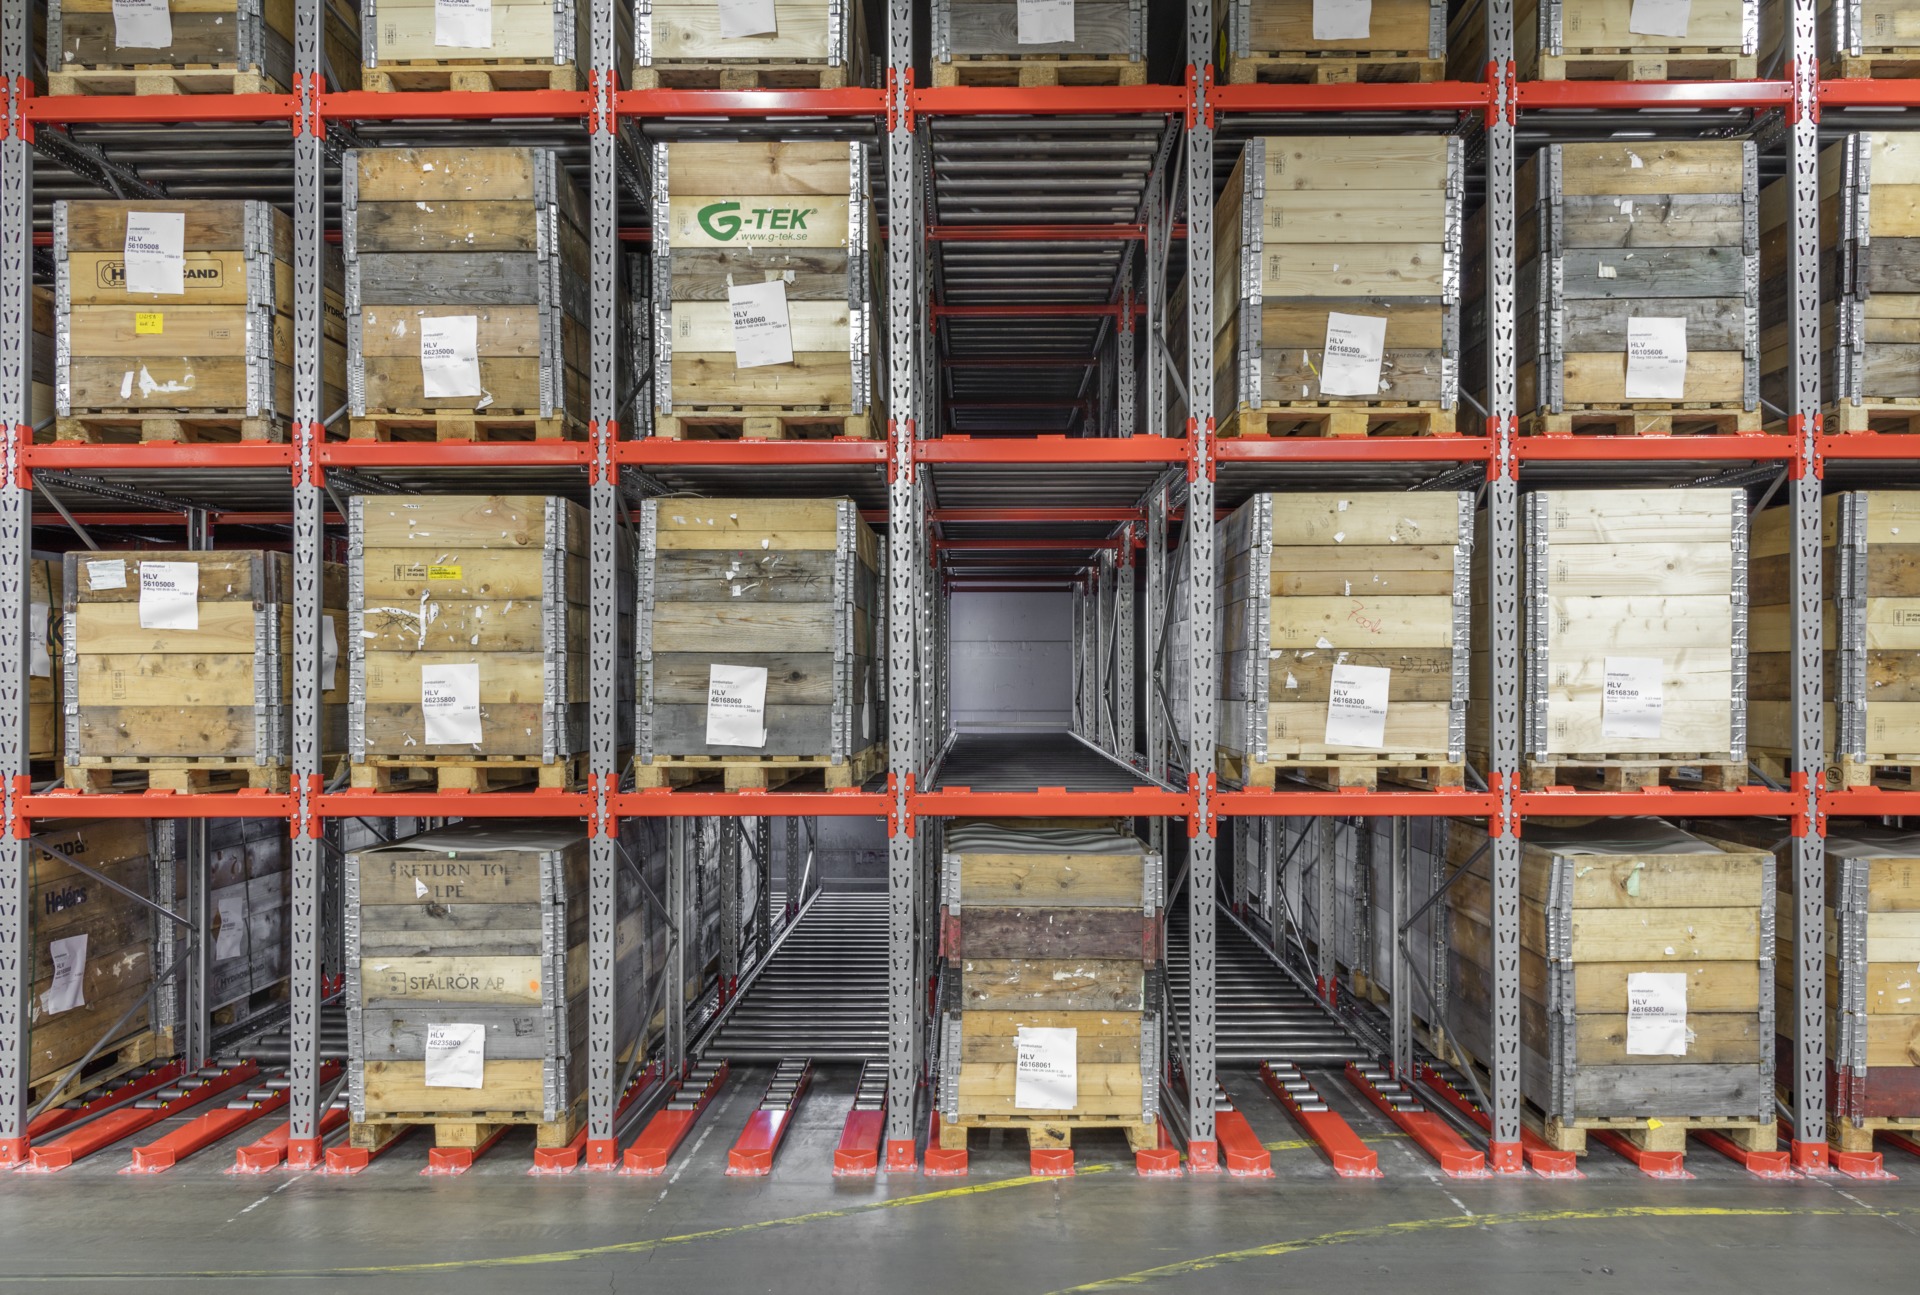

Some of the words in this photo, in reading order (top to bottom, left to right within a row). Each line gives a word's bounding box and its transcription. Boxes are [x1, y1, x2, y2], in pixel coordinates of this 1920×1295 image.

[741, 232, 808, 242] www.g-tek.se
[735, 316, 766, 325] 46168060
[1329, 345, 1360, 354] 46168300
[400, 864, 470, 878] RETURN
[46, 886, 87, 915] Heléns
[410, 973, 480, 990] STÅLRÖR
